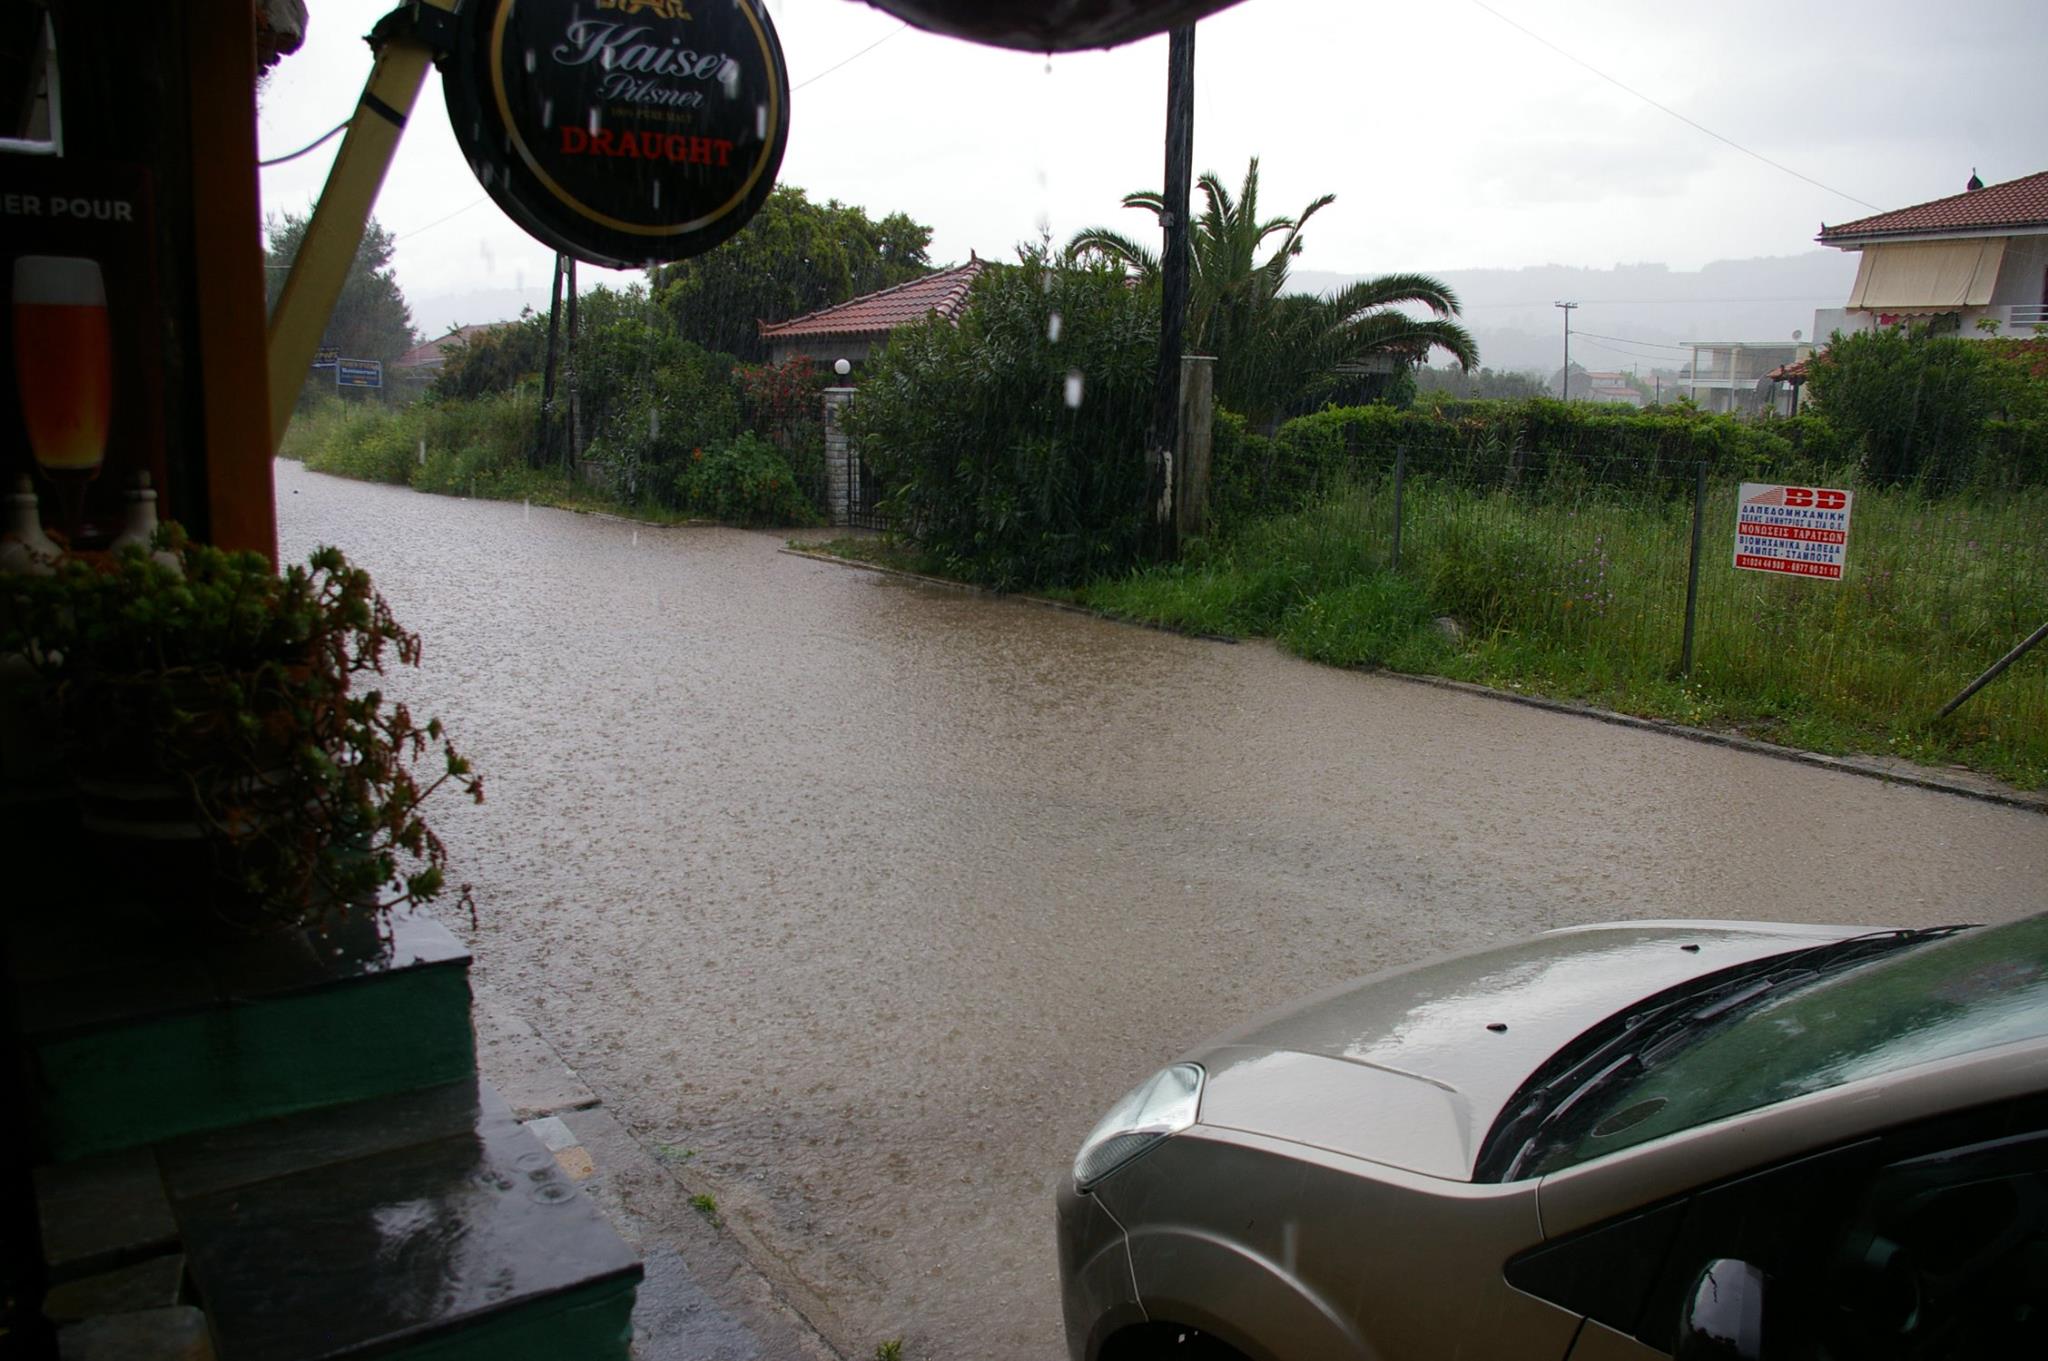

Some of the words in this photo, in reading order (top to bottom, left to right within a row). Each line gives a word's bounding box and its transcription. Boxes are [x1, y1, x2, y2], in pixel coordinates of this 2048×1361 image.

[552, 20, 738, 84] Kaiser
[597, 72, 704, 109] Pilsner
[559, 126, 734, 167] DRAUGHT
[0, 193, 43, 216] ER
[50, 197, 134, 222] POUR
[1742, 505, 1845, 521] ΔΑΠΕΔΟΜΗΧΑΝΙΚΗ
[1784, 488, 1846, 510] BD
[1740, 523, 1789, 537] ΜΟΝΩΣΕΙΣ
[1793, 528, 1843, 542] ΤΑΡΑΤΣΩΝ
